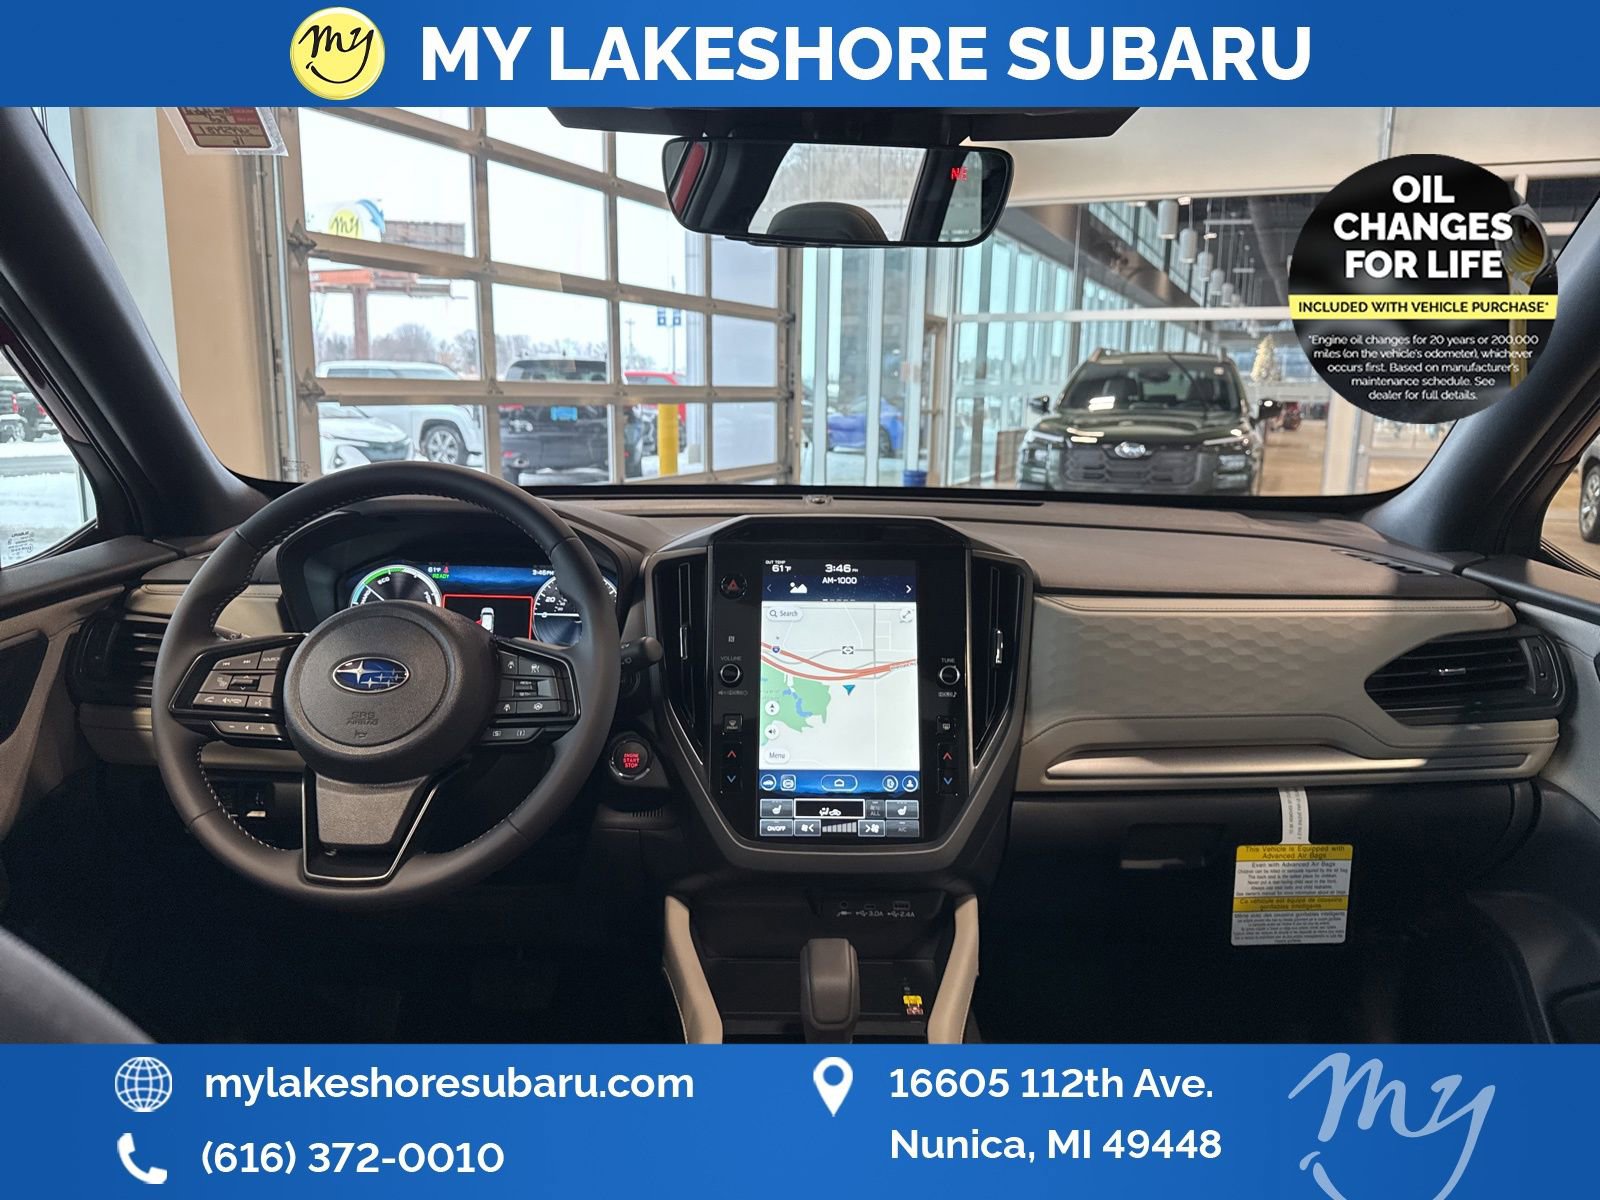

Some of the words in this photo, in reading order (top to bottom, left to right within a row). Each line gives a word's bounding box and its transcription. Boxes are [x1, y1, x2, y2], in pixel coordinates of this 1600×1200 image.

[951, 167, 968, 181] NE
[825, 564, 852, 573] 3:46
[822, 576, 858, 584] AM-1000
